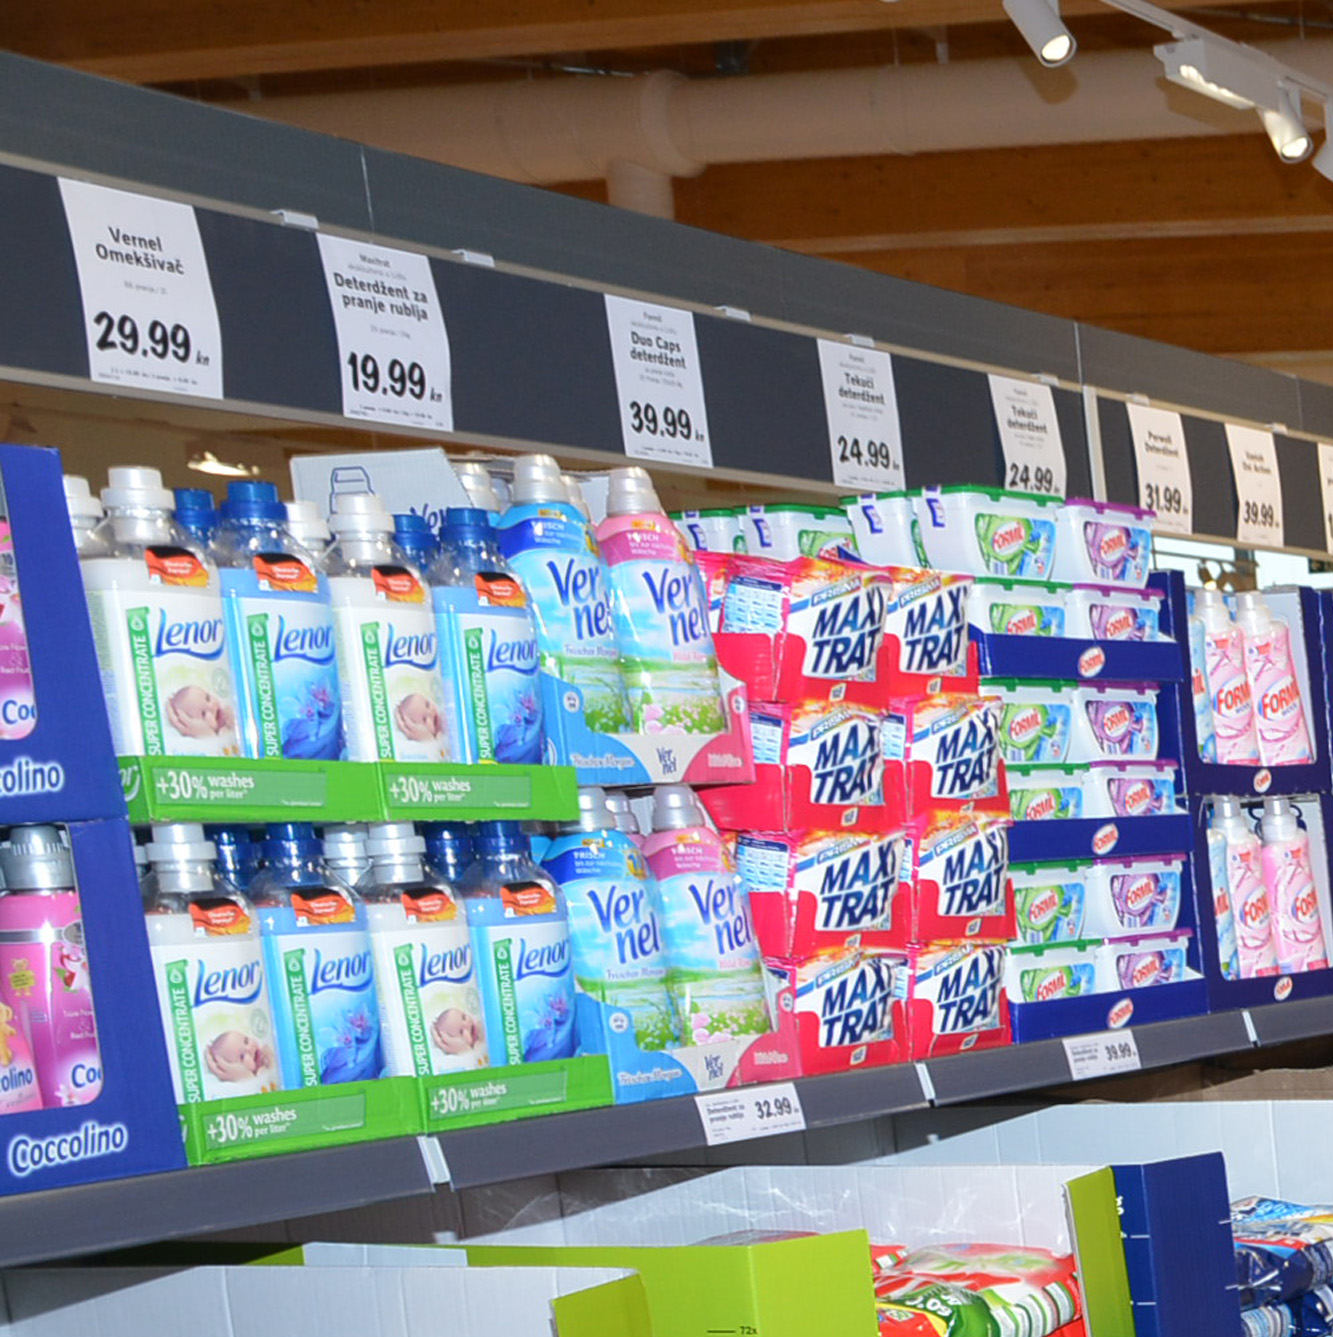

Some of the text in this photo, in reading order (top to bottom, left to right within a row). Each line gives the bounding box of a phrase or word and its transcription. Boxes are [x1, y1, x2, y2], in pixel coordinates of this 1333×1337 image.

[96, 243, 185, 275] Omekšivač
[108, 226, 163, 252] Vernel
[333, 272, 409, 300] Deterdžent
[413, 290, 428, 304] za
[341, 293, 428, 322] pranje rublja
[94, 311, 191, 363] 29.99
[630, 330, 681, 354] Duo Caps
[630, 347, 686, 369] deterdžent
[347, 351, 426, 401] 19.99
[629, 400, 692, 441] 39.99
[838, 435, 891, 469] 24.99
[1010, 463, 1054, 493] 24.99
[1145, 484, 1182, 513] 31.99
[1243, 500, 1274, 526] 39.99
[547, 558, 599, 602] Ver
[643, 568, 693, 614] Ver
[152, 607, 226, 660] Lenor
[273, 614, 336, 665] Lenor
[384, 623, 437, 670] Lenor
[486, 628, 539, 676] Lenor
[129, 634, 163, 755] SUPER CONCENTRATE
[252, 640, 279, 757] SUPER CONCENTRATE
[365, 646, 393, 758] SUPER CONCENTRATE
[467, 651, 492, 758] SUPER CONCENTRATE
[156, 770, 208, 802] +30%
[209, 772, 255, 789] washes
[389, 775, 432, 803] +30%
[432, 777, 472, 792] washes
[587, 884, 645, 933] Ver
[688, 878, 737, 925] Ver
[617, 913, 661, 964] nel
[715, 914, 753, 955] nel
[310, 948, 374, 995] Lenor
[418, 944, 471, 988] Lenor
[516, 939, 570, 981] Lenor
[193, 959, 263, 1007] Lenor
[289, 976, 318, 1087] SUPER CONCENTRATE
[399, 965, 432, 1075] SUPER CONCENTRATE
[496, 961, 523, 1065] SUPER CONCENTRATE
[171, 987, 201, 1104] SUPER CONCENTRATE
[430, 1086, 471, 1114] +30%
[470, 1082, 507, 1097] washes
[755, 1097, 792, 1120] 32.99
[207, 1113, 253, 1143] +30%
[252, 1109, 297, 1125] washes
[11, 1124, 126, 1170] Coccolino
[740, 1326, 758, 1336] 72x
